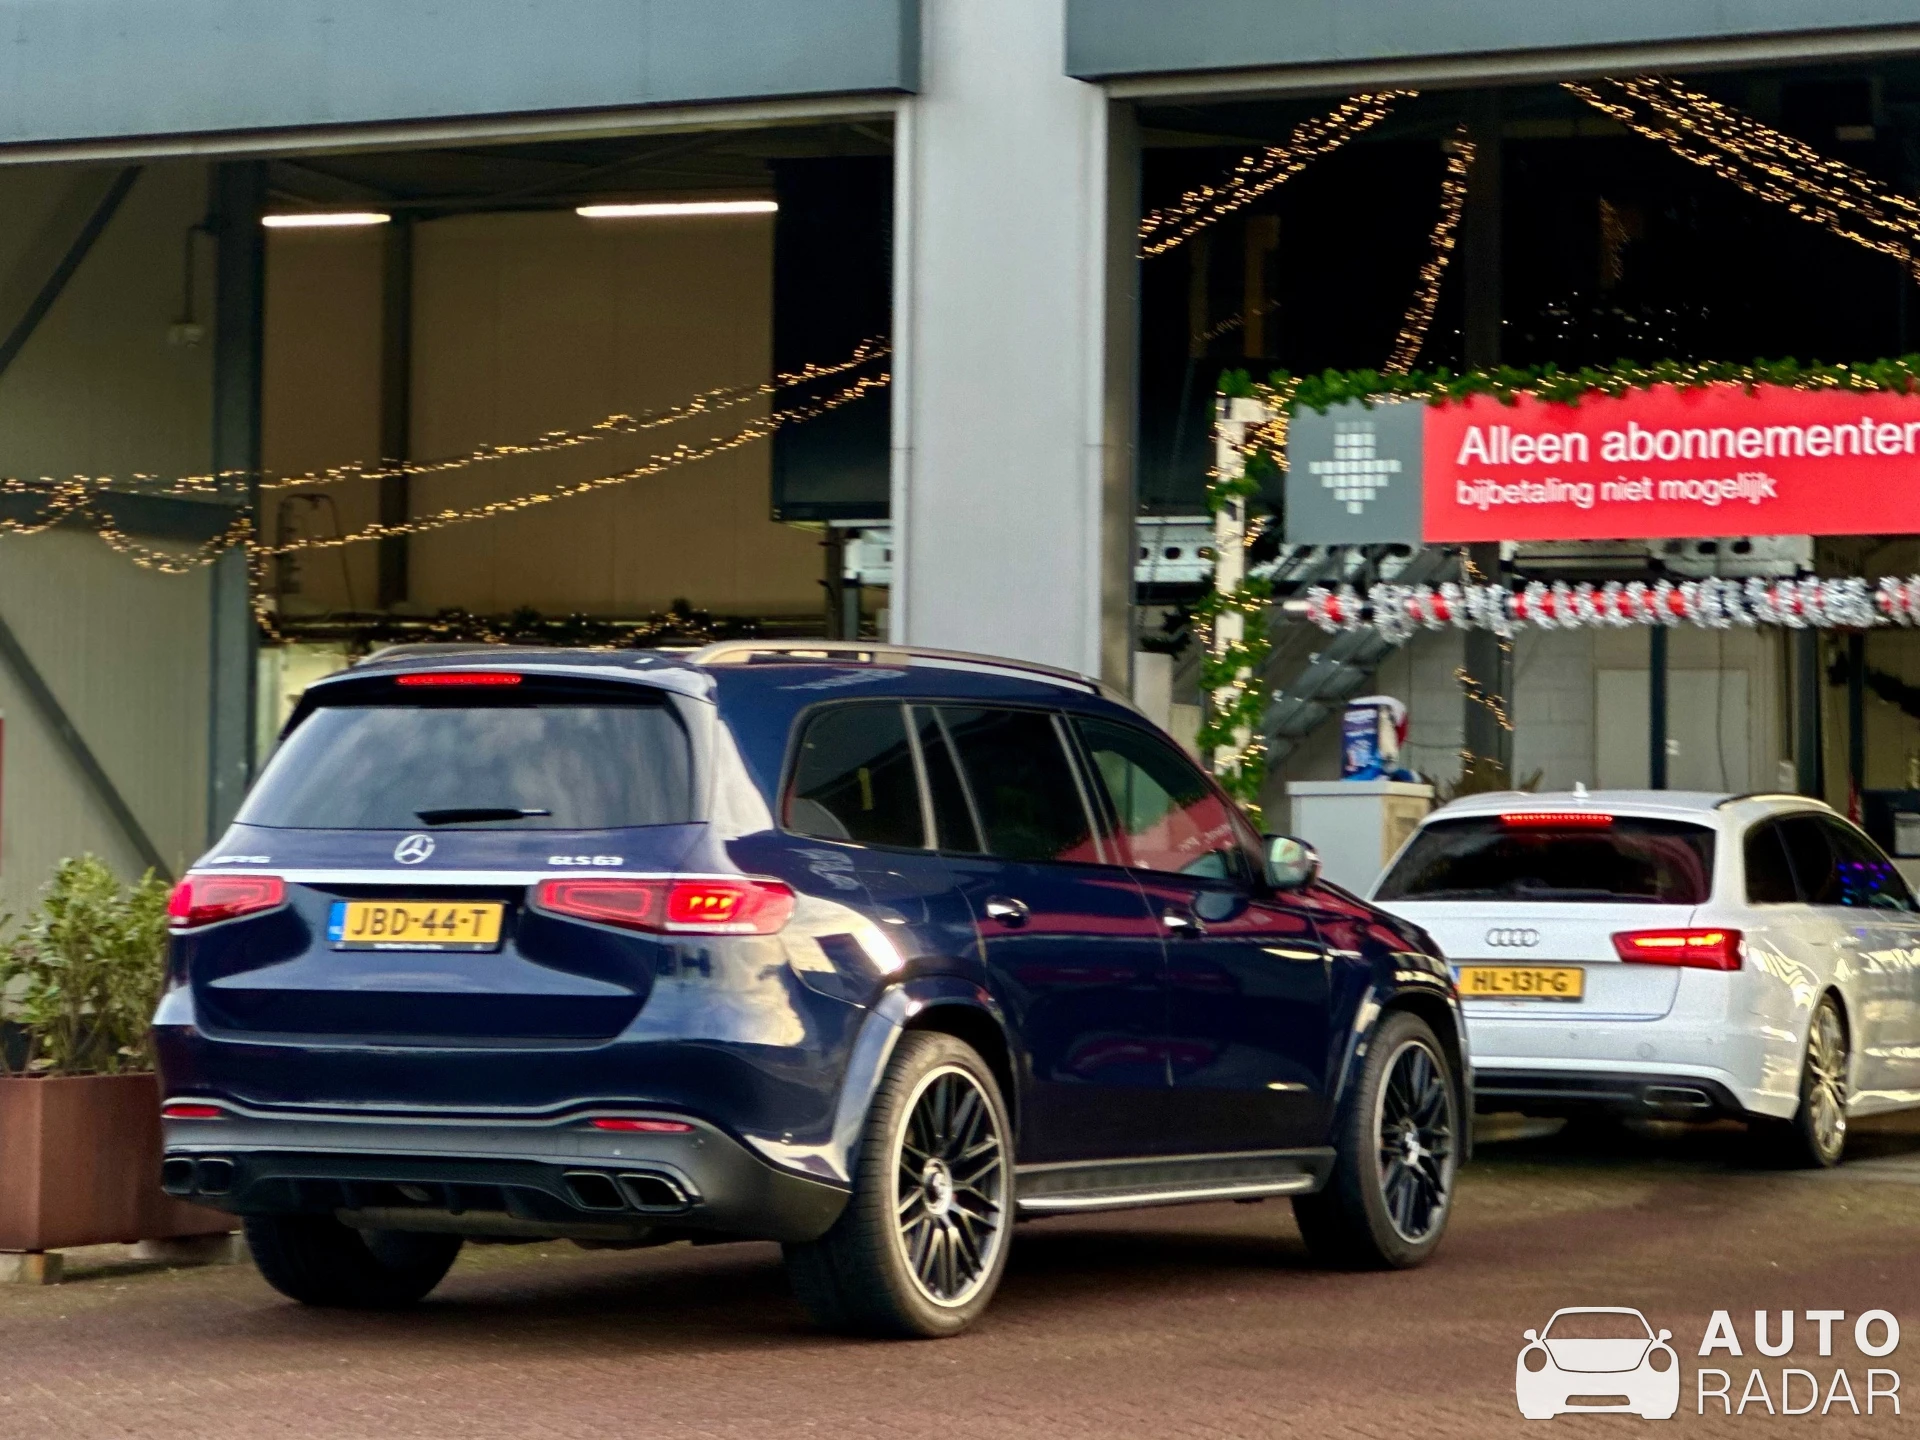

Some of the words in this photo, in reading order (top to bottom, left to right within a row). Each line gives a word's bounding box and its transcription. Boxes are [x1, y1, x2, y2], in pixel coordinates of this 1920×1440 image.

[1457, 425, 1590, 466] Alleen
[1456, 478, 1595, 511] bijbetaling
[1600, 475, 1654, 501] niet
[1658, 472, 1778, 506] mogelijk
[352, 907, 488, 937] JBD-44-T
[1472, 970, 1569, 992] HL-131-G
